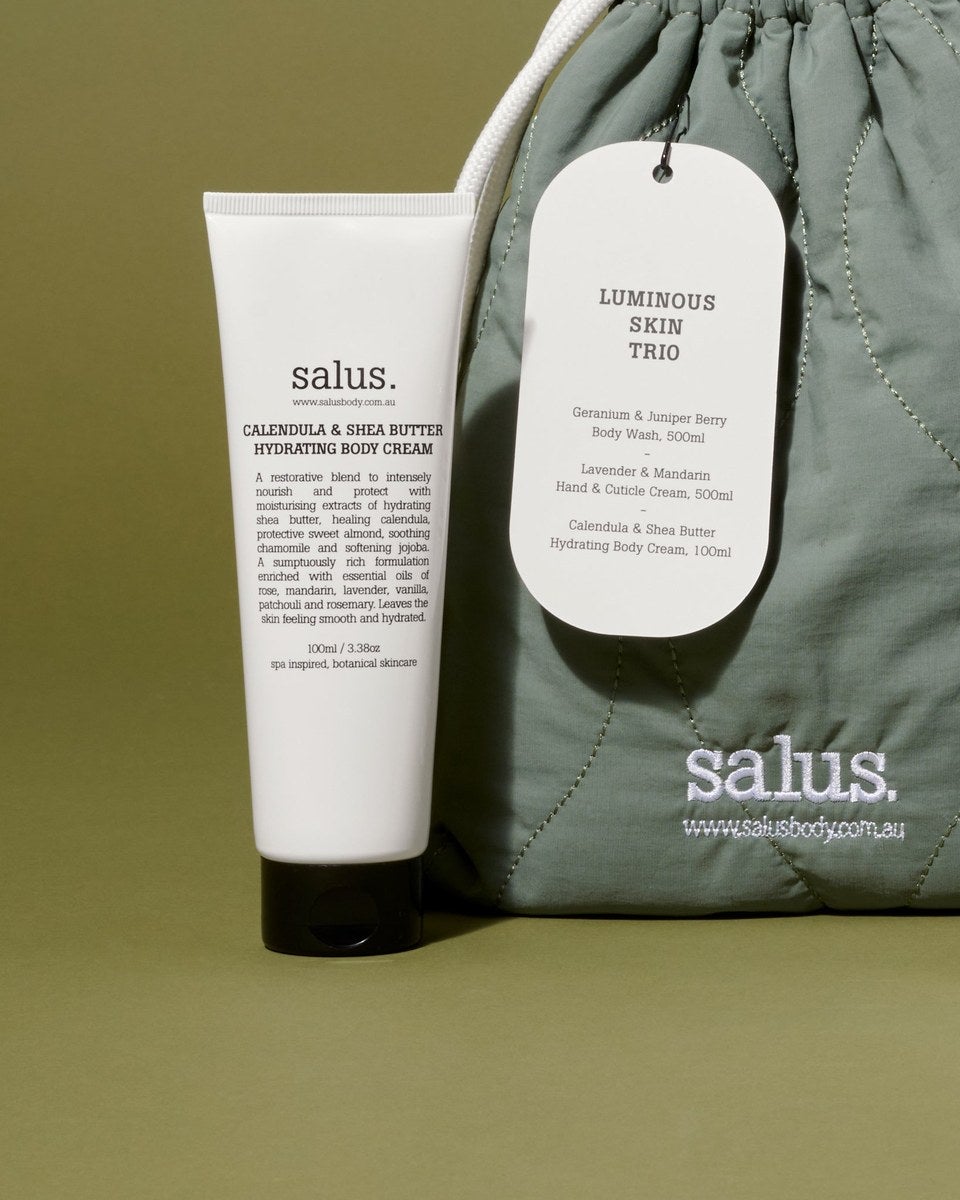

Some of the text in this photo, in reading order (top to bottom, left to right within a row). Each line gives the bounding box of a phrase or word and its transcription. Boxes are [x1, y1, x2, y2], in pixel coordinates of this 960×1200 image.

[599, 288, 716, 312] LUMINOUS
[629, 316, 684, 336] SKIN
[628, 341, 680, 361] TRIO
[292, 360, 396, 390] salus.
[292, 398, 396, 408] www.salusbody.com.au
[572, 406, 727, 429] Geranium & Juniper Berry
[243, 423, 444, 437] CALENDULA & SHEA BUTTER
[591, 426, 705, 444] Body Wash, 500ml
[254, 442, 433, 455] HYDRATING BODY CREAM
[255, 471, 432, 485] A restorative blend to intensely
[581, 463, 711, 481] Lavender & Mandarin
[256, 486, 431, 499] nourish and protect with
[555, 480, 733, 501] Hand & Cuticle Cream, 500ml
[256, 500, 431, 513] moisturising extracts of hydrating
[256, 514, 430, 527] shea butter, healing calendula,
[568, 519, 716, 538] Calendula & Shea Butter
[257, 527, 431, 542] protective sweet almond, soothing
[549, 537, 732, 558] Hydrating Body Cream, 100ml
[257, 555, 430, 570] A sumptuously rich formulation
[308, 643, 337, 654] 100ml
[347, 643, 381, 653] 3.38oz
[270, 658, 418, 671] spa inspired, botanical skincare
[685, 733, 898, 804] salus.
[682, 815, 905, 844] www.salusbody.com.au
